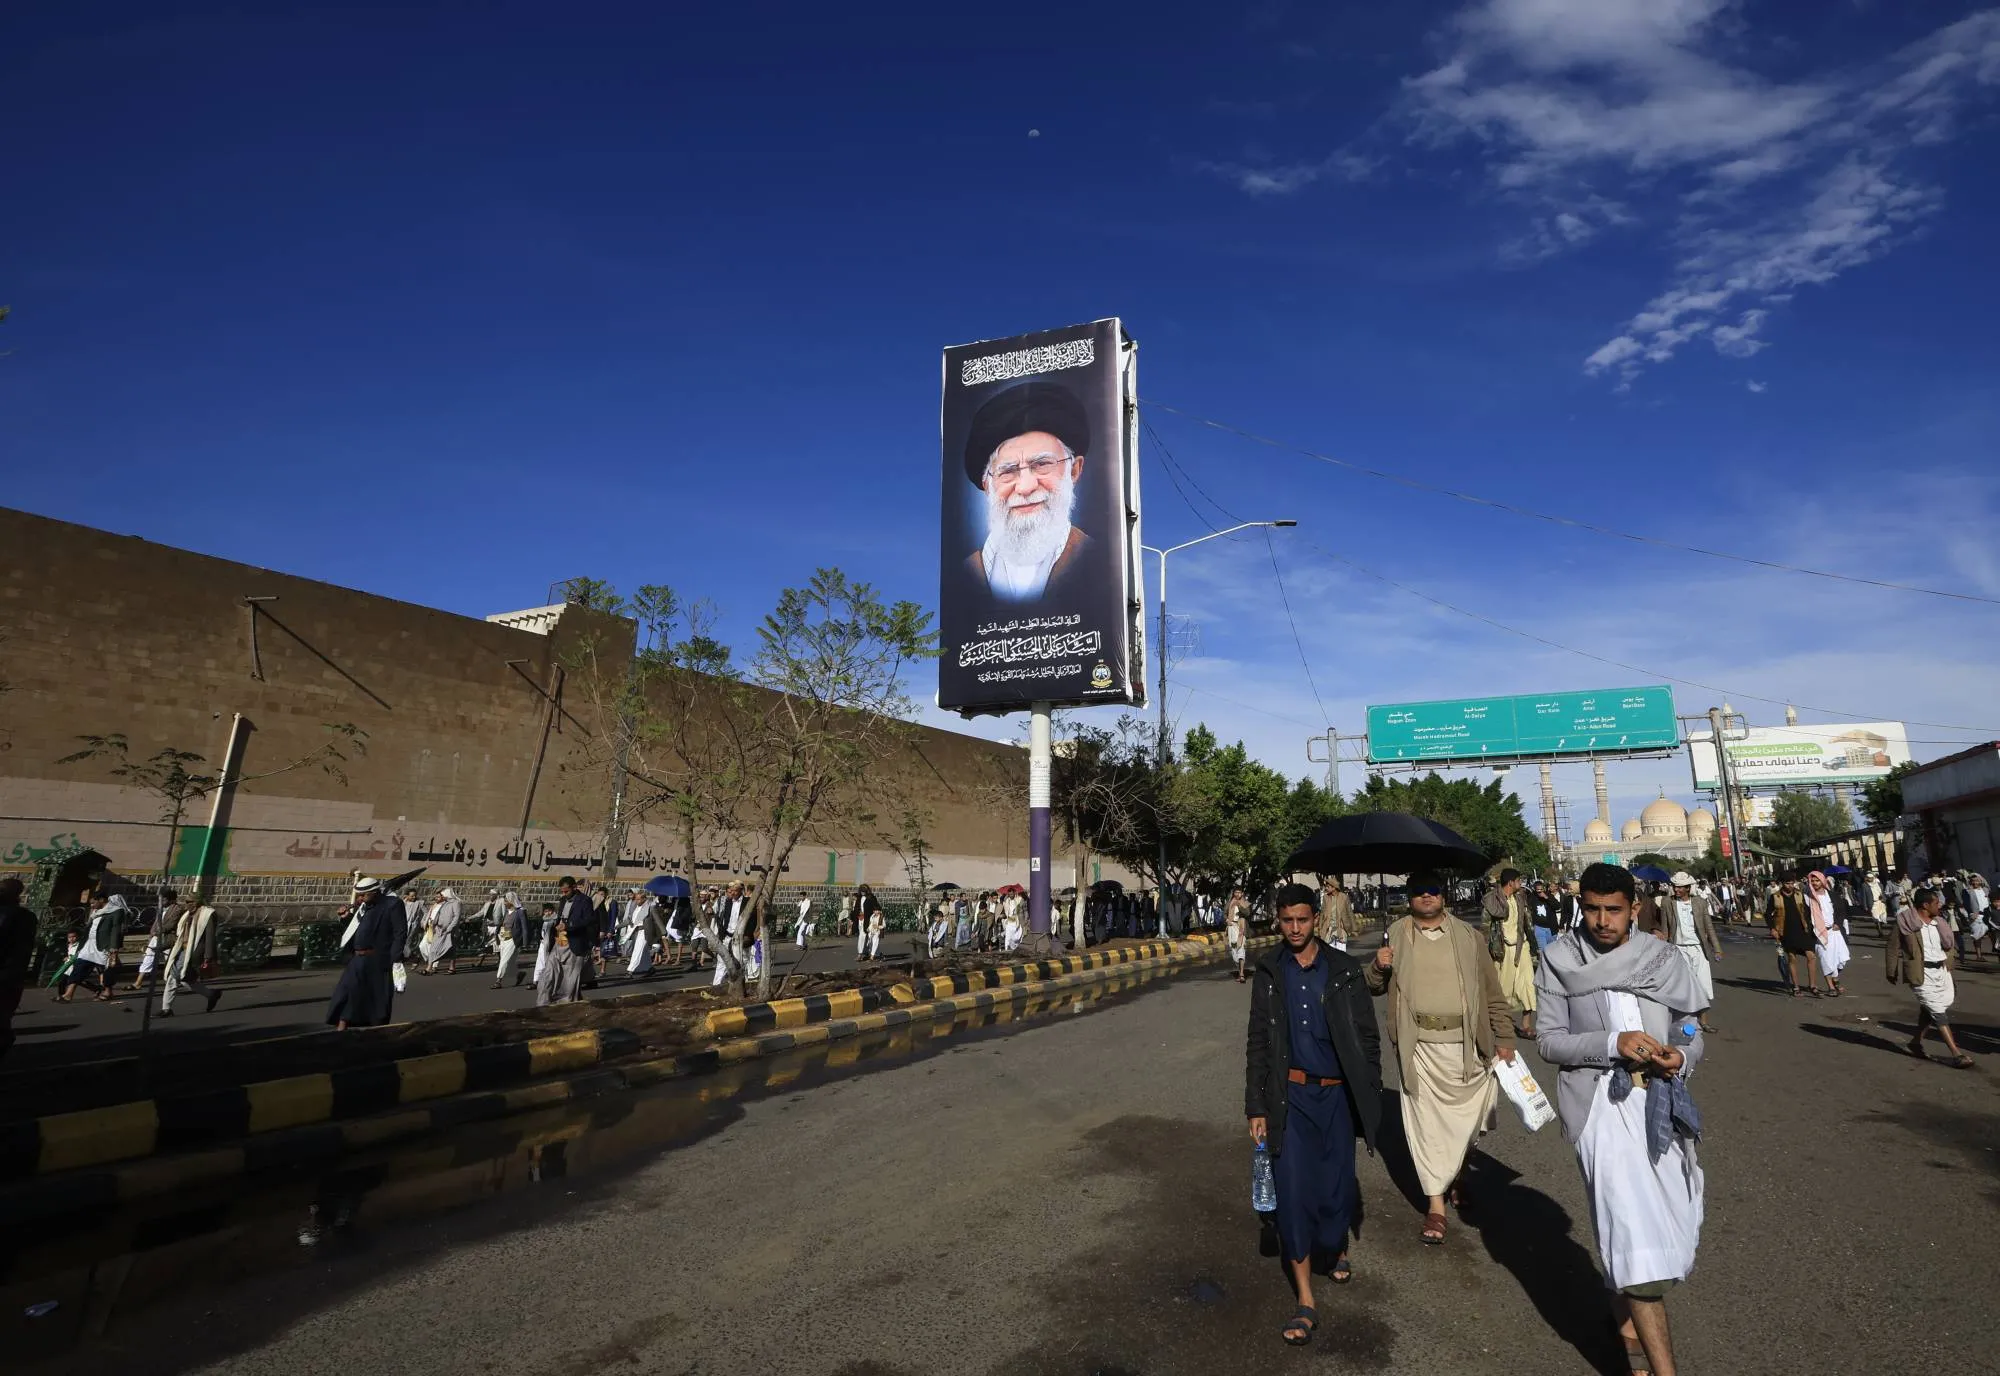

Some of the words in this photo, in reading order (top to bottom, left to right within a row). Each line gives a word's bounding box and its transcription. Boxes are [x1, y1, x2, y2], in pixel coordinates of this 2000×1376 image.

[997, 620, 1019, 634] الشهيد
[1796, 756, 1821, 765] دعنا
[659, 856, 681, 873] بين
